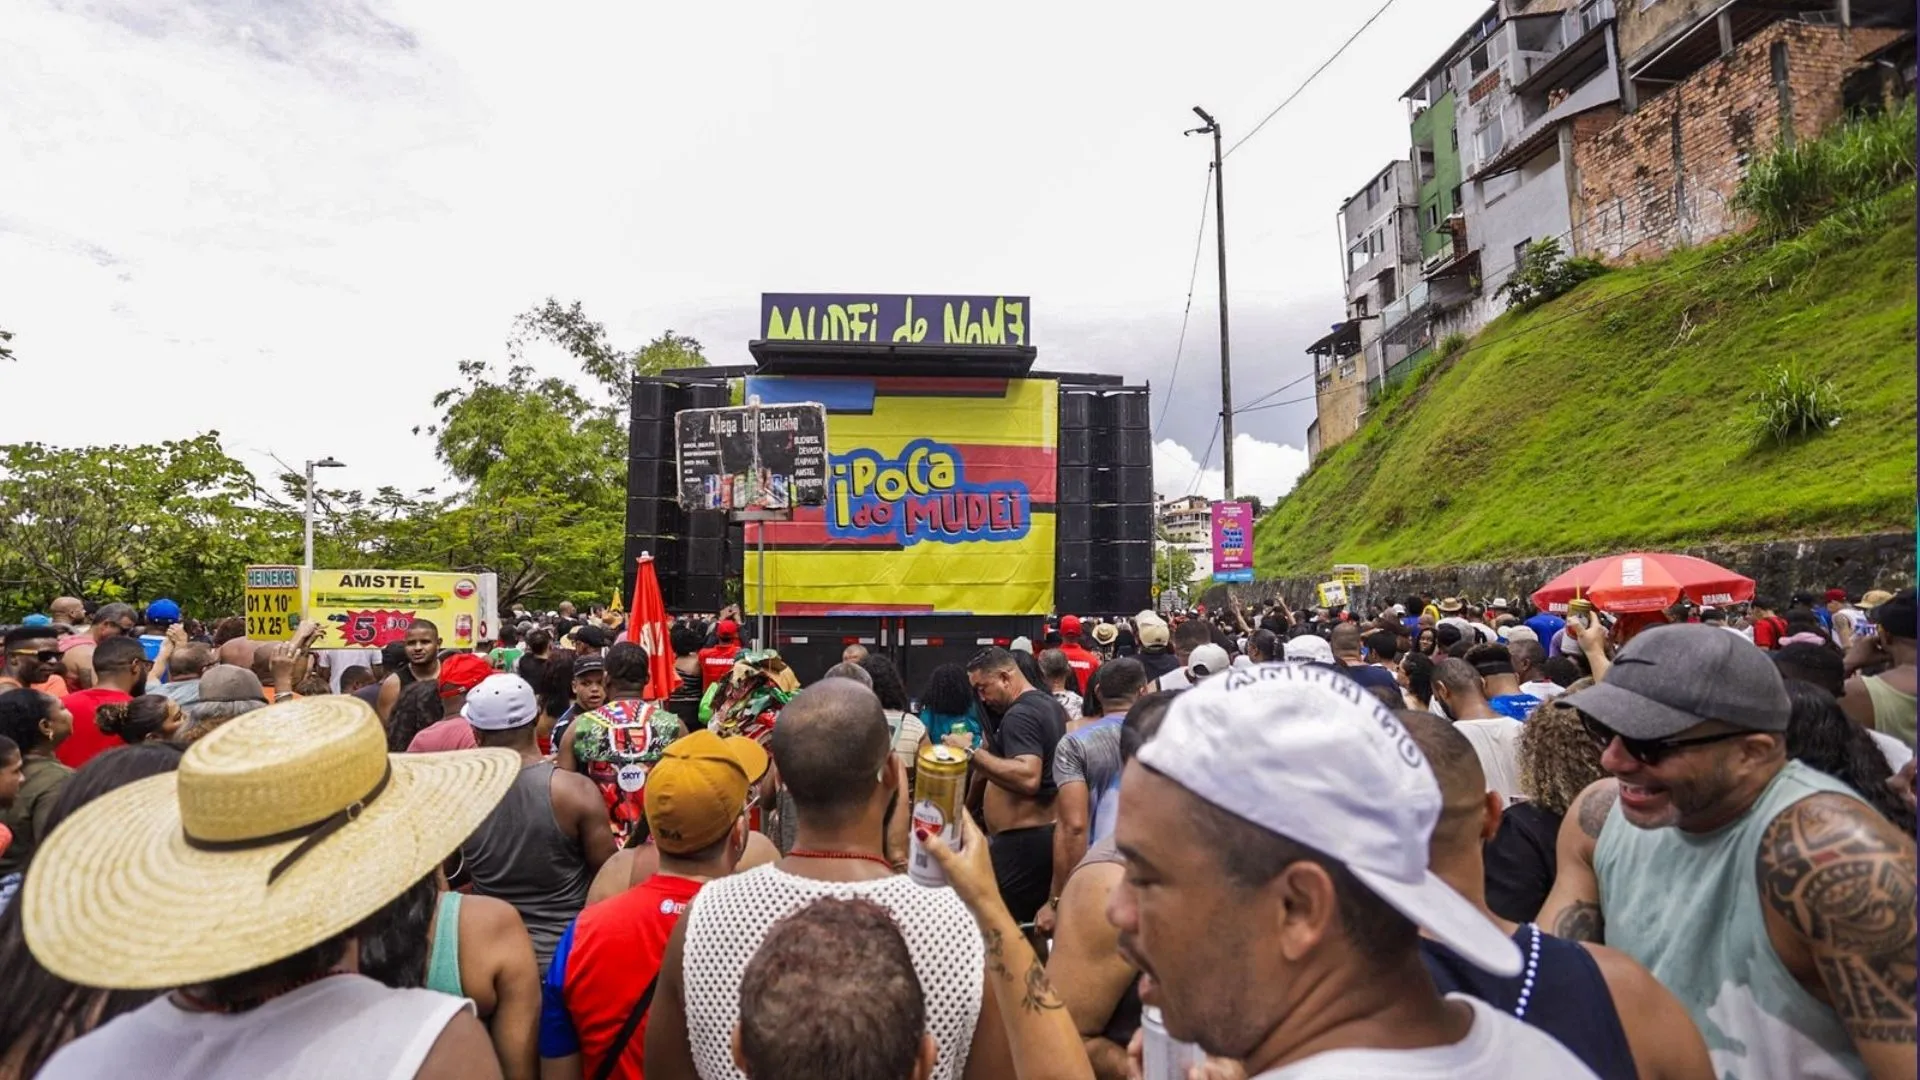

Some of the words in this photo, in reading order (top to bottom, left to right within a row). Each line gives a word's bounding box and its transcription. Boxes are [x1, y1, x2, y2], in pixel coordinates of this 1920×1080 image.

[760, 411, 799, 432] Baixinho
[852, 503, 894, 530] do
[248, 570, 297, 586] HEINEKEN
[339, 574, 425, 590] AMSTEL
[247, 594, 260, 612] 01
[264, 594, 271, 612] X
[1702, 593, 1733, 605] BRAHMA
[248, 616, 255, 635] 3
[258, 616, 266, 635] X
[621, 772, 641, 780] SKYY
